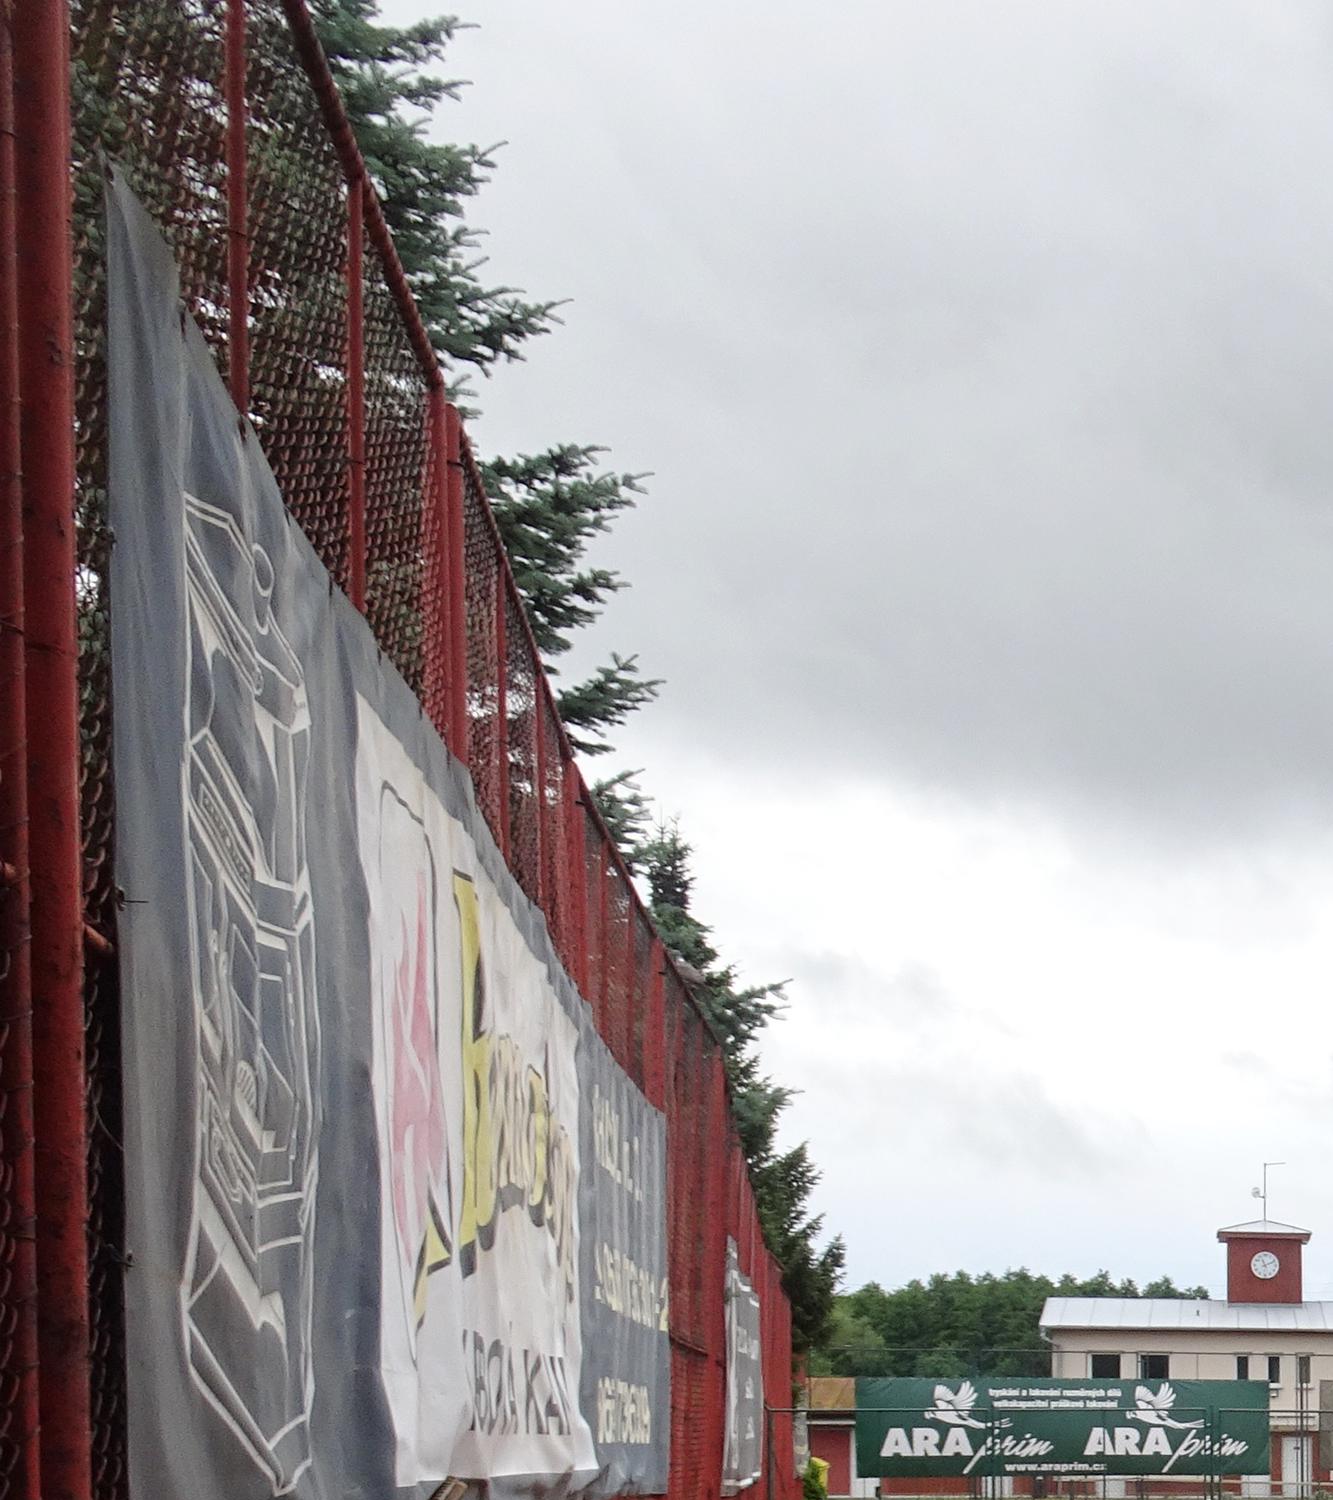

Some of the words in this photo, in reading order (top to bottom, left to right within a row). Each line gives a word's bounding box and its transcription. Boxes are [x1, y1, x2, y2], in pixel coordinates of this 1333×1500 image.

[1028, 1388, 1061, 1397] lakování
[1086, 1399, 1119, 1408] lakování
[880, 1427, 974, 1457] ARA
[963, 1429, 1054, 1474] prim
[1083, 1427, 1173, 1455] ARA
[1161, 1429, 1249, 1473] prim
